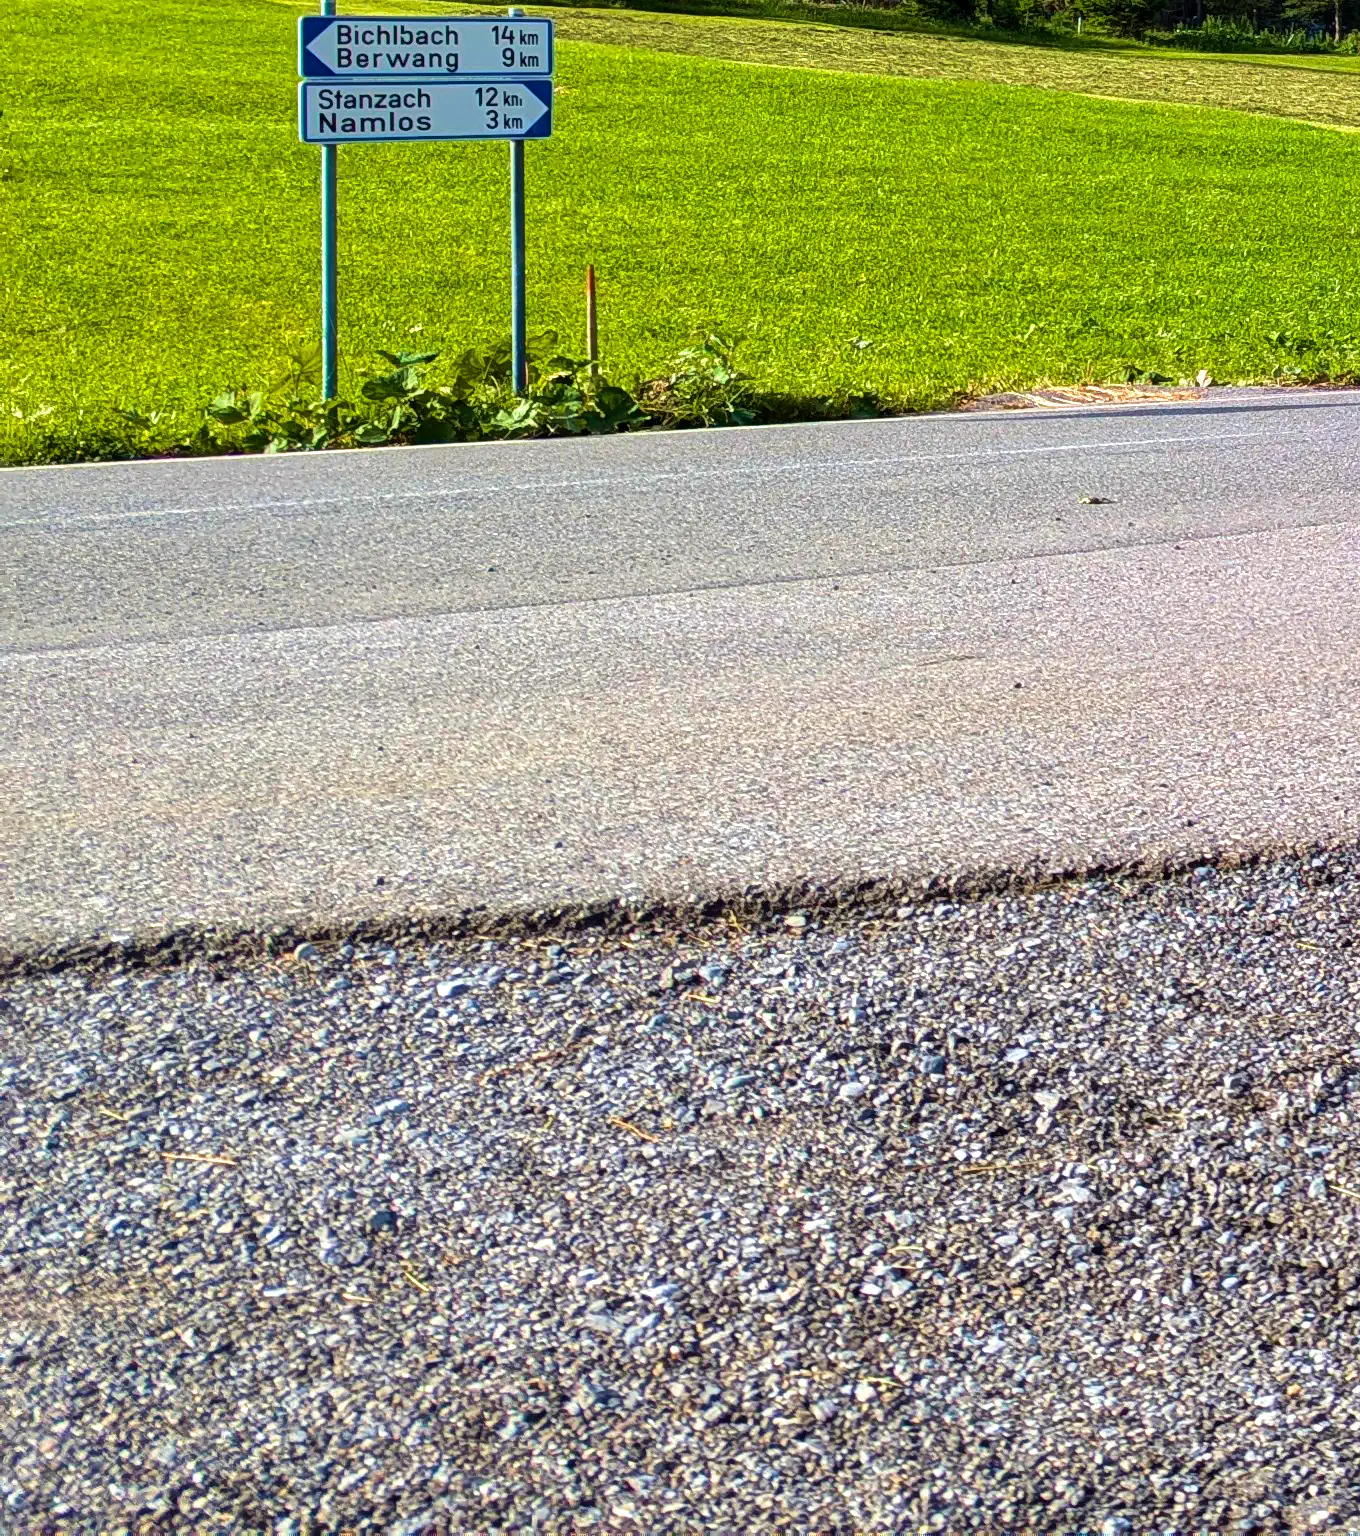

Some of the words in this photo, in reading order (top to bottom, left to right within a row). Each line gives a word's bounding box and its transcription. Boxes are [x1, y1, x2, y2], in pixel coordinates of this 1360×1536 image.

[337, 25, 459, 45] Bichlbach
[491, 25, 515, 45] 14
[519, 30, 539, 45] km
[337, 47, 459, 72] Berwang
[502, 48, 515, 67] 9
[519, 52, 539, 67] km
[318, 88, 431, 110] Stanzach
[475, 87, 499, 107] 12
[318, 112, 432, 133] Namlos
[486, 110, 499, 129] 3
[503, 113, 523, 129] km
